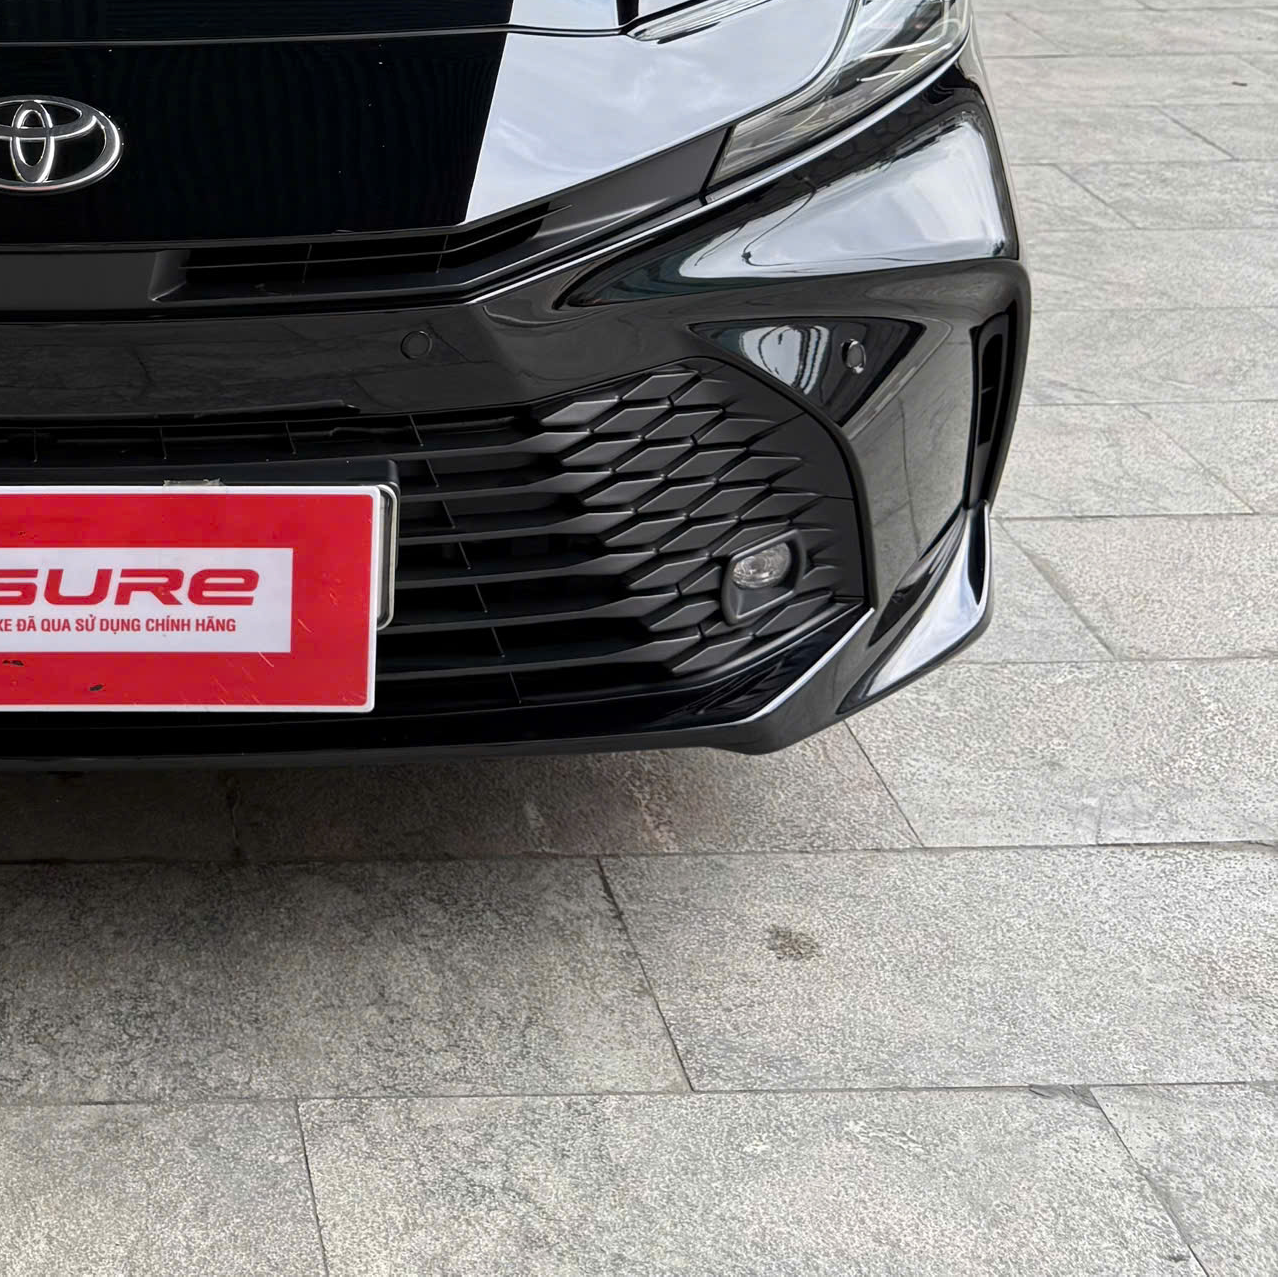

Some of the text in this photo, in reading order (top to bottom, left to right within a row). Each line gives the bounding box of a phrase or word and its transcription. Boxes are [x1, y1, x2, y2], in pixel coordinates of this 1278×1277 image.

[16, 616, 38, 632] ĐÃ
[40, 618, 72, 633] QUA
[75, 614, 97, 633] SỬ
[99, 618, 142, 636] DỤNG
[145, 615, 192, 633] CHÍNH
[195, 616, 237, 633] HÃNG
